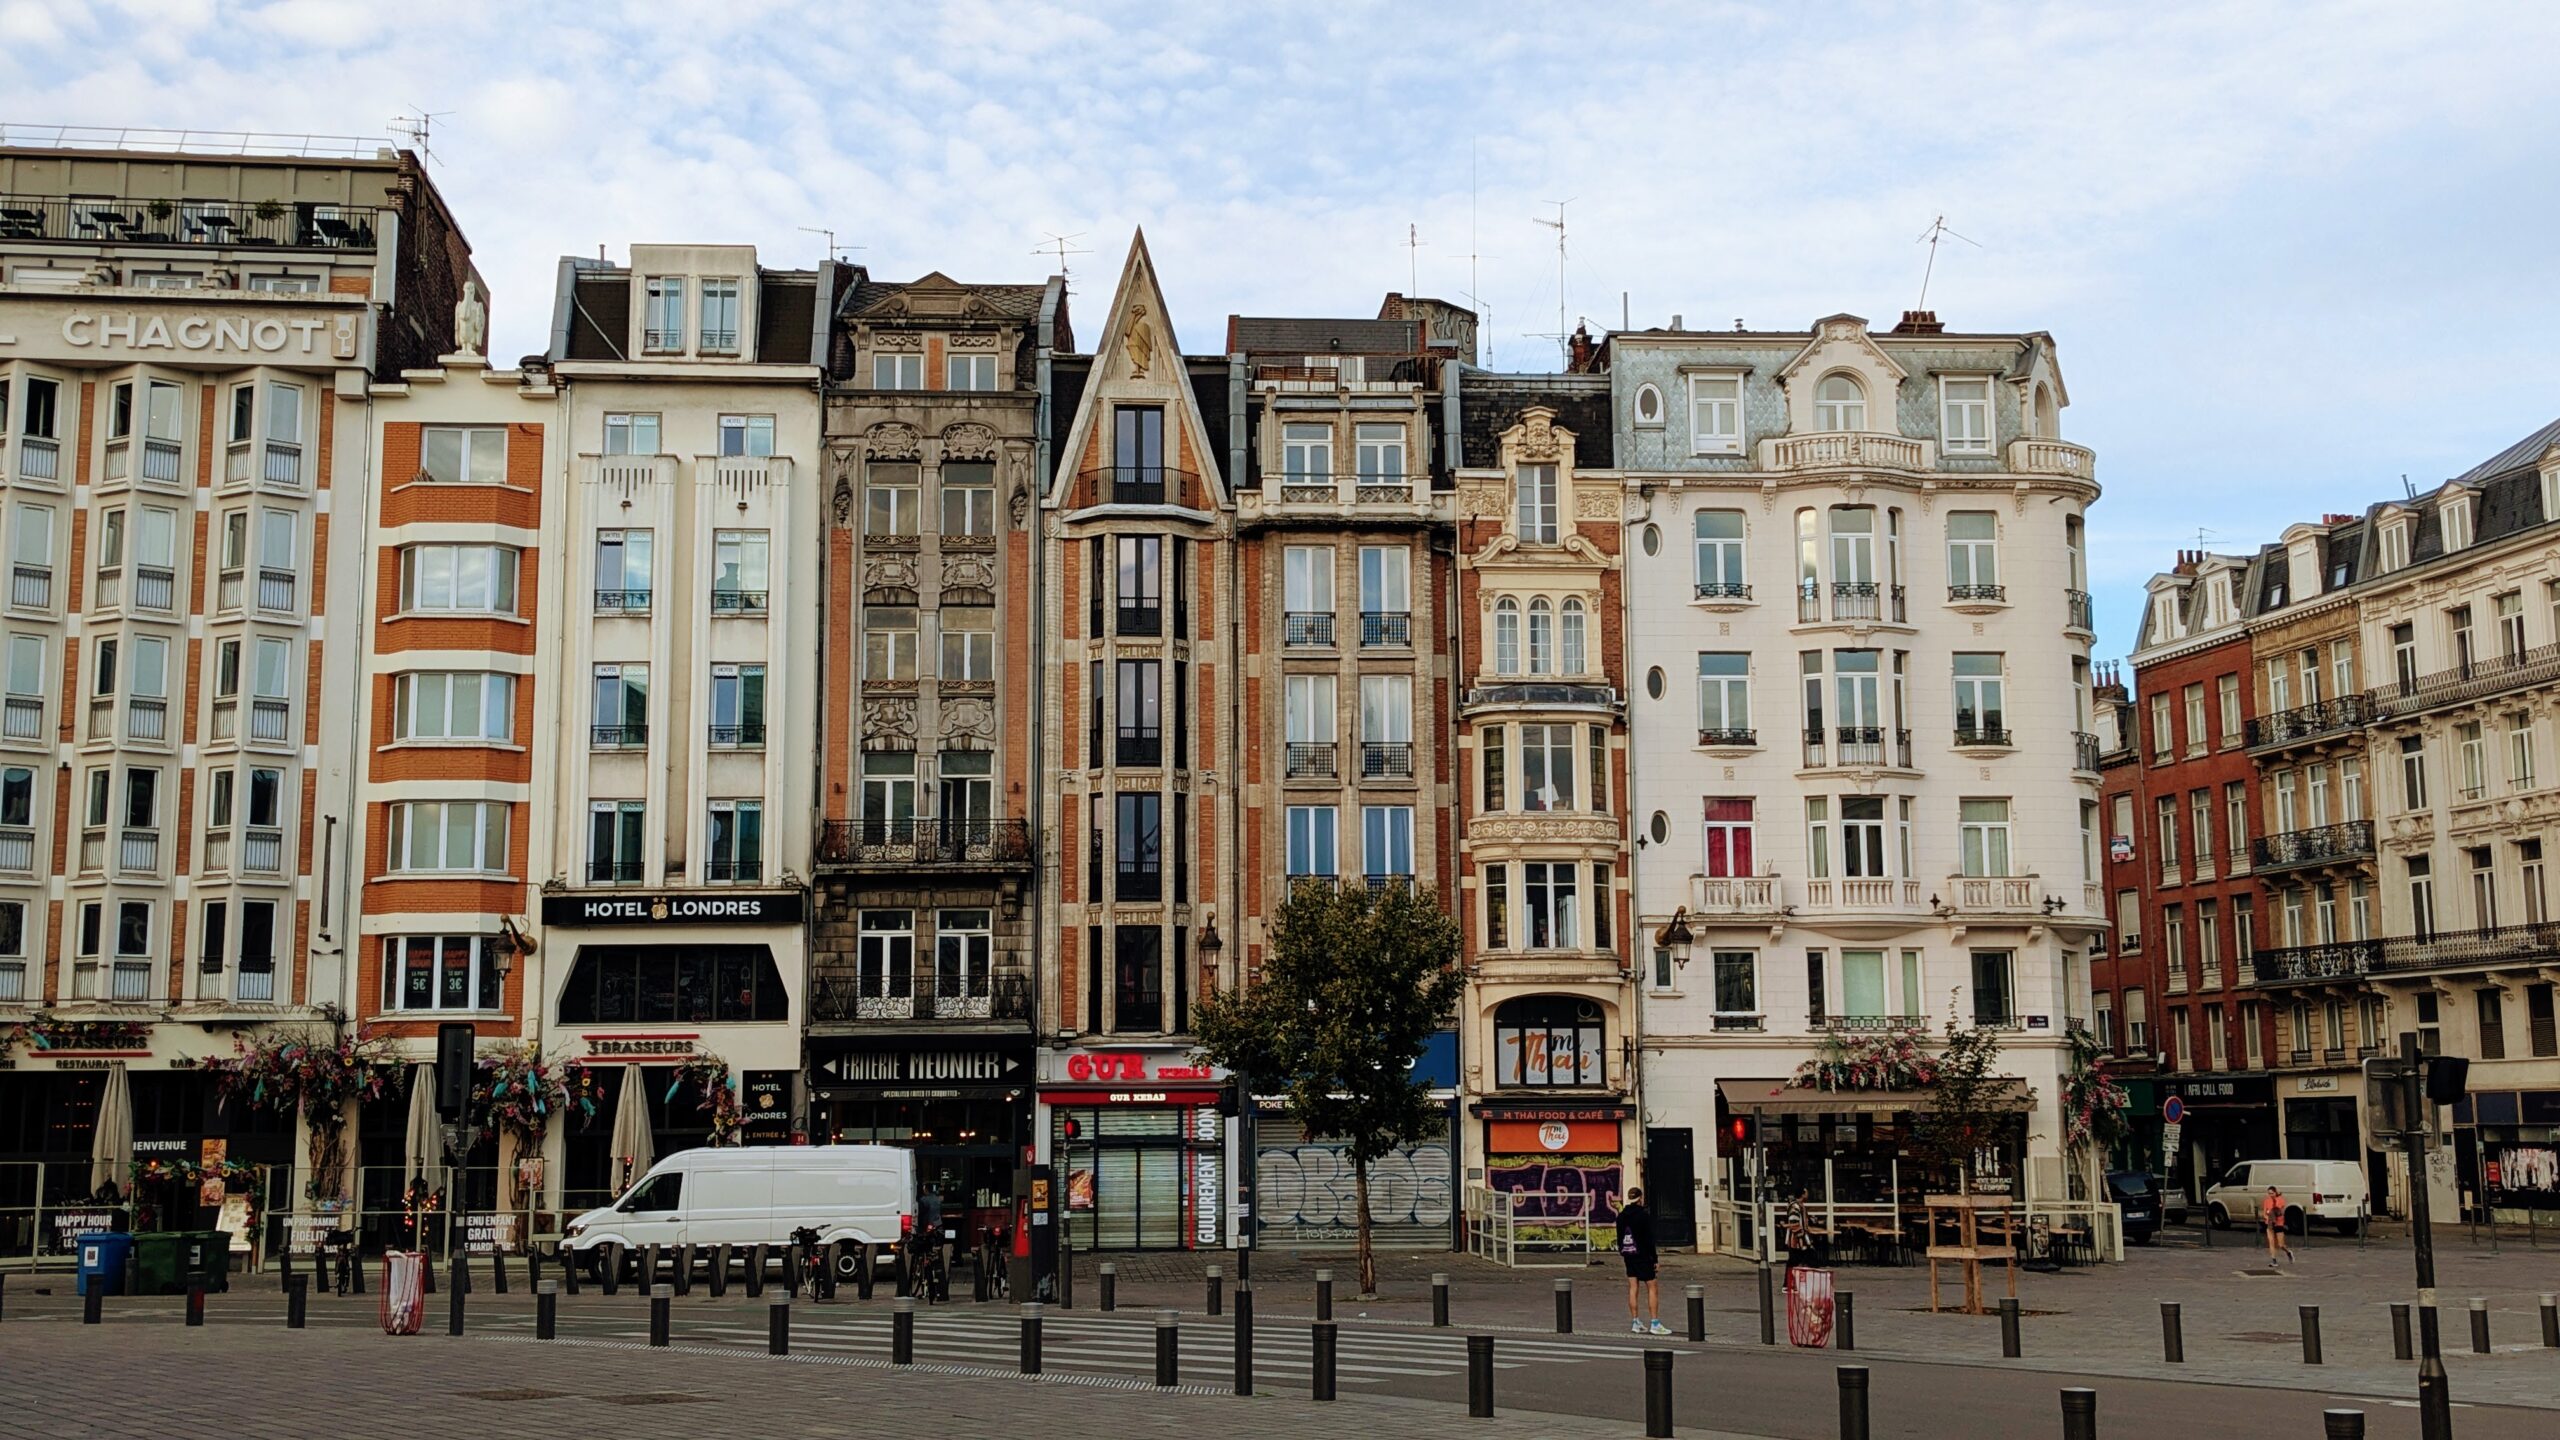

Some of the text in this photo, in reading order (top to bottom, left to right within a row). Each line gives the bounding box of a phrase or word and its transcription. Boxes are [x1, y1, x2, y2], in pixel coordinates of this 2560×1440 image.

[62, 314, 325, 352] CHAGNOT
[1090, 647, 1102, 659] AU
[1116, 647, 1162, 657] PELICAN
[1089, 779, 1101, 792] AU
[1115, 778, 1162, 790] PELICAN
[584, 902, 647, 917] HOTEL
[672, 901, 761, 916] LONDRES
[1088, 912, 1101, 925] AU
[1115, 912, 1163, 924] PELICAN
[412, 978, 426, 990] 5€
[449, 978, 462, 990] 3€
[587, 1041, 693, 1055] 3 BRASSEURS
[843, 1051, 999, 1080] FRITERIE MEUNIER
[1068, 1054, 1146, 1080] GUR
[752, 1083, 782, 1091] HOTEL
[1133, 1093, 1166, 1101] KEBAB
[1259, 1101, 1282, 1109] POKE
[745, 1112, 787, 1120] LONDRES
[1578, 1110, 1603, 1119] CAFÉ
[132, 1141, 187, 1151] IENVENUE
[1198, 1154, 1216, 1243] GUUUREMENT
[55, 1215, 112, 1227] HAPPY HOUR
[283, 1217, 339, 1227] UN PROGRAMME
[466, 1215, 517, 1226] ENU ENFANT
[62, 1228, 71, 1237] LA
[467, 1228, 508, 1241] GRATUIT
[63, 1238, 72, 1248] LE
[469, 1242, 493, 1252] MARDI
